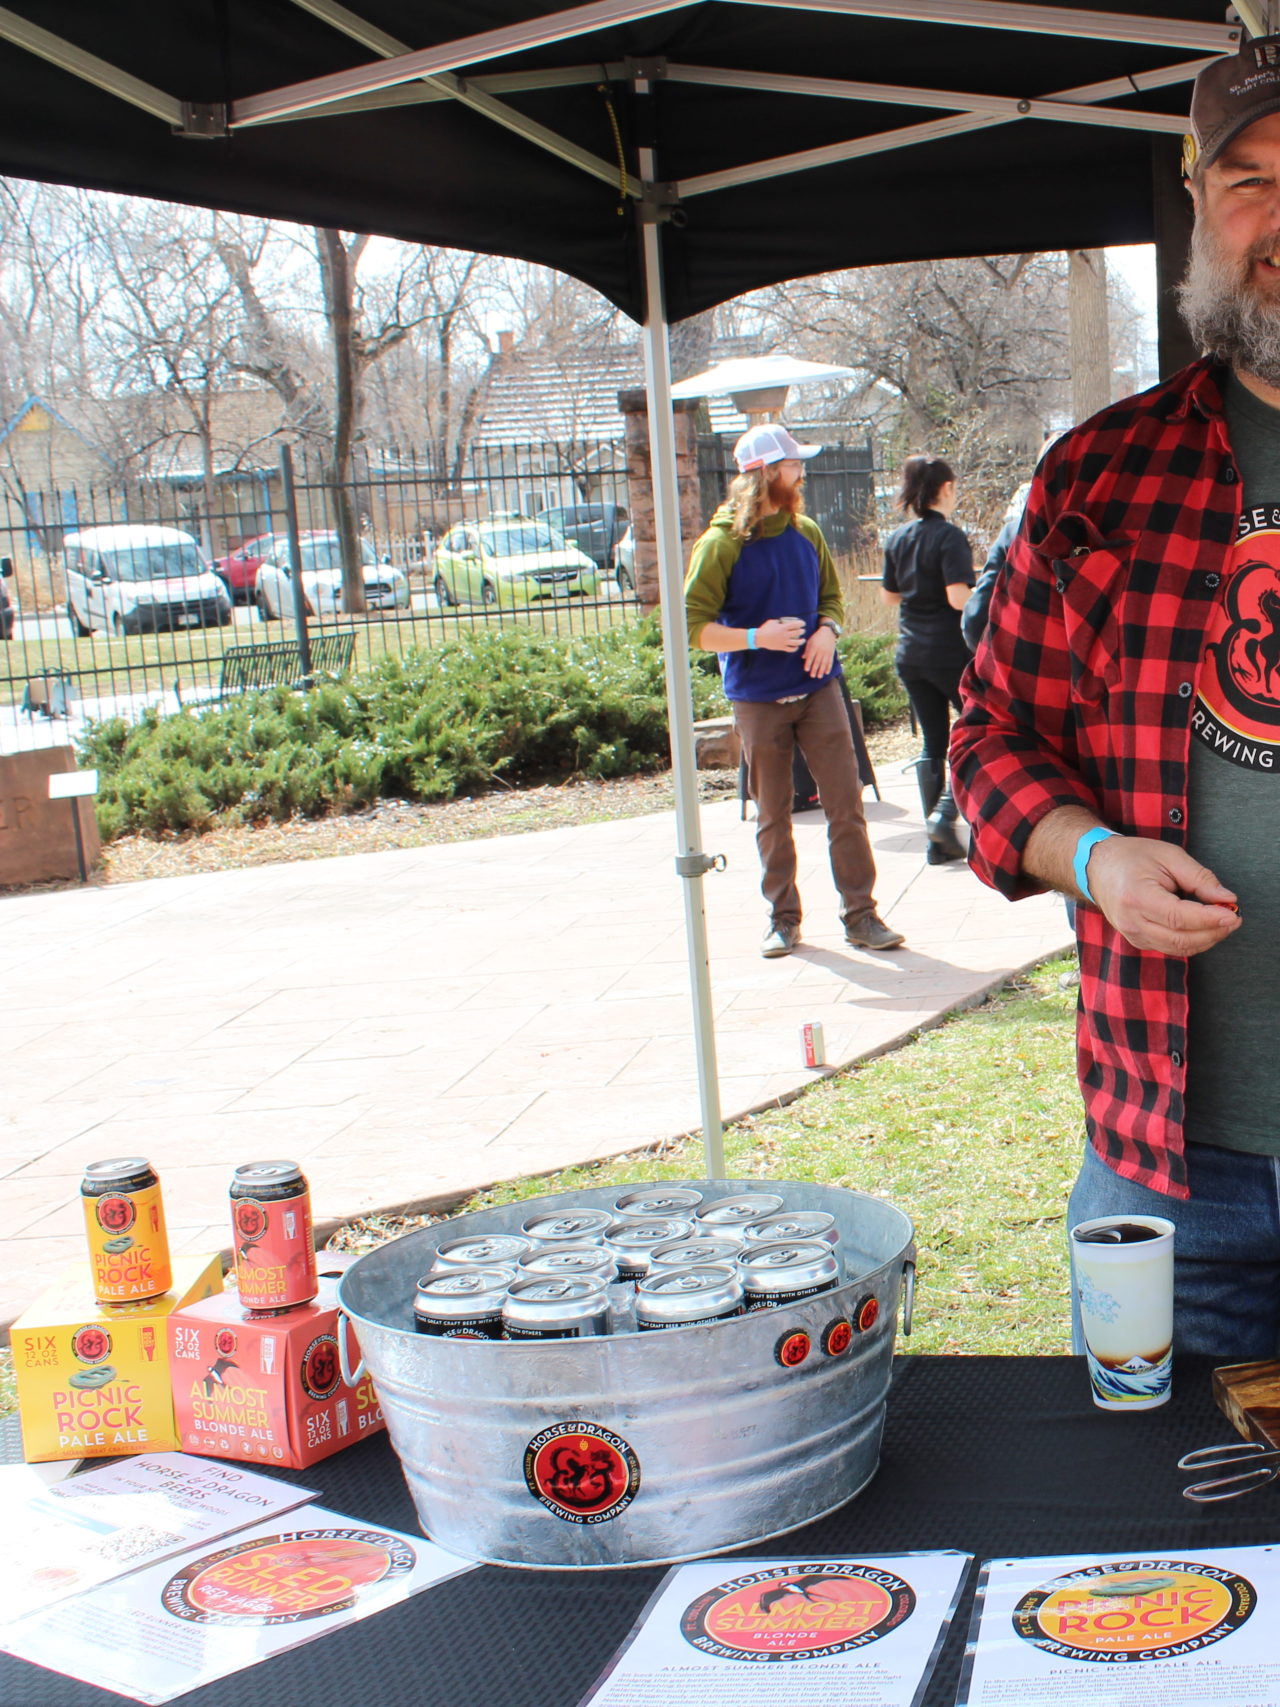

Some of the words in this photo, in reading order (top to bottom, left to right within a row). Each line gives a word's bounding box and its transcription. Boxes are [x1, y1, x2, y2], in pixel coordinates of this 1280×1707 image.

[1192, 705, 1274, 768] REWING
[95, 1248, 152, 1267] PICNIC
[97, 1262, 153, 1283] ROCK
[98, 1286, 125, 1296] PALE
[130, 1280, 156, 1294] ALE
[269, 1294, 287, 1304] ALE
[24, 1335, 57, 1351] SIX
[175, 1327, 200, 1343] SIX
[462, 1327, 489, 1340] DRAGO
[25, 1351, 36, 1359] 12
[42, 1349, 57, 1358] OZ
[175, 1341, 184, 1349] 12
[187, 1343, 200, 1351] OZ
[175, 1350, 200, 1361] CANS
[25, 1358, 59, 1368] CANS
[53, 1385, 142, 1410] PICNIC
[189, 1380, 268, 1409] ALMOST
[57, 1406, 144, 1433] ROCK
[192, 1402, 270, 1428] SUMMER
[307, 1410, 329, 1431] SIX
[59, 1432, 105, 1448] PALE
[114, 1429, 148, 1443] ALE
[194, 1419, 246, 1436] BLONDE
[251, 1428, 274, 1440] ALE
[307, 1430, 316, 1440] 12
[320, 1423, 330, 1433] OZ
[529, 1424, 567, 1451] HORSE
[577, 1423, 629, 1453] DRAGON
[307, 1432, 331, 1448] CANS
[133, 1461, 189, 1480] HORSE
[203, 1481, 274, 1507] DRAGON
[202, 1466, 243, 1482] FIND
[159, 1480, 212, 1500] BEERS
[539, 1496, 583, 1523] BREWING
[587, 1495, 632, 1523] COMPANY
[279, 1529, 362, 1544] HORSE
[379, 1536, 409, 1578] DRAGON
[235, 1553, 352, 1596] SLED
[719, 1565, 801, 1595] HORSE
[822, 1564, 906, 1593] DRAGON
[1137, 1561, 1237, 1582] DRAGON
[165, 1579, 192, 1617] BREWING
[197, 1584, 230, 1599] RED
[206, 1566, 319, 1610] RUNNER
[717, 1600, 883, 1618] ALMOST
[1057, 1588, 1214, 1614] PICNIC
[1234, 1582, 1247, 1617] COLORADO
[715, 1615, 870, 1631] SUMMER
[1058, 1604, 1216, 1634] ROCK
[752, 1631, 819, 1639] BLONDE
[766, 1639, 797, 1647] ALE
[1036, 1638, 1128, 1662] BREWING
[1138, 1622, 1235, 1661] COMPANY
[1095, 1634, 1135, 1643] PALE
[1142, 1632, 1173, 1641] ALE
[692, 1636, 770, 1662] BREWING
[779, 1630, 880, 1661] COMPANY
[1050, 1667, 1100, 1675] PICNIC
[1107, 1664, 1146, 1672] ROCK
